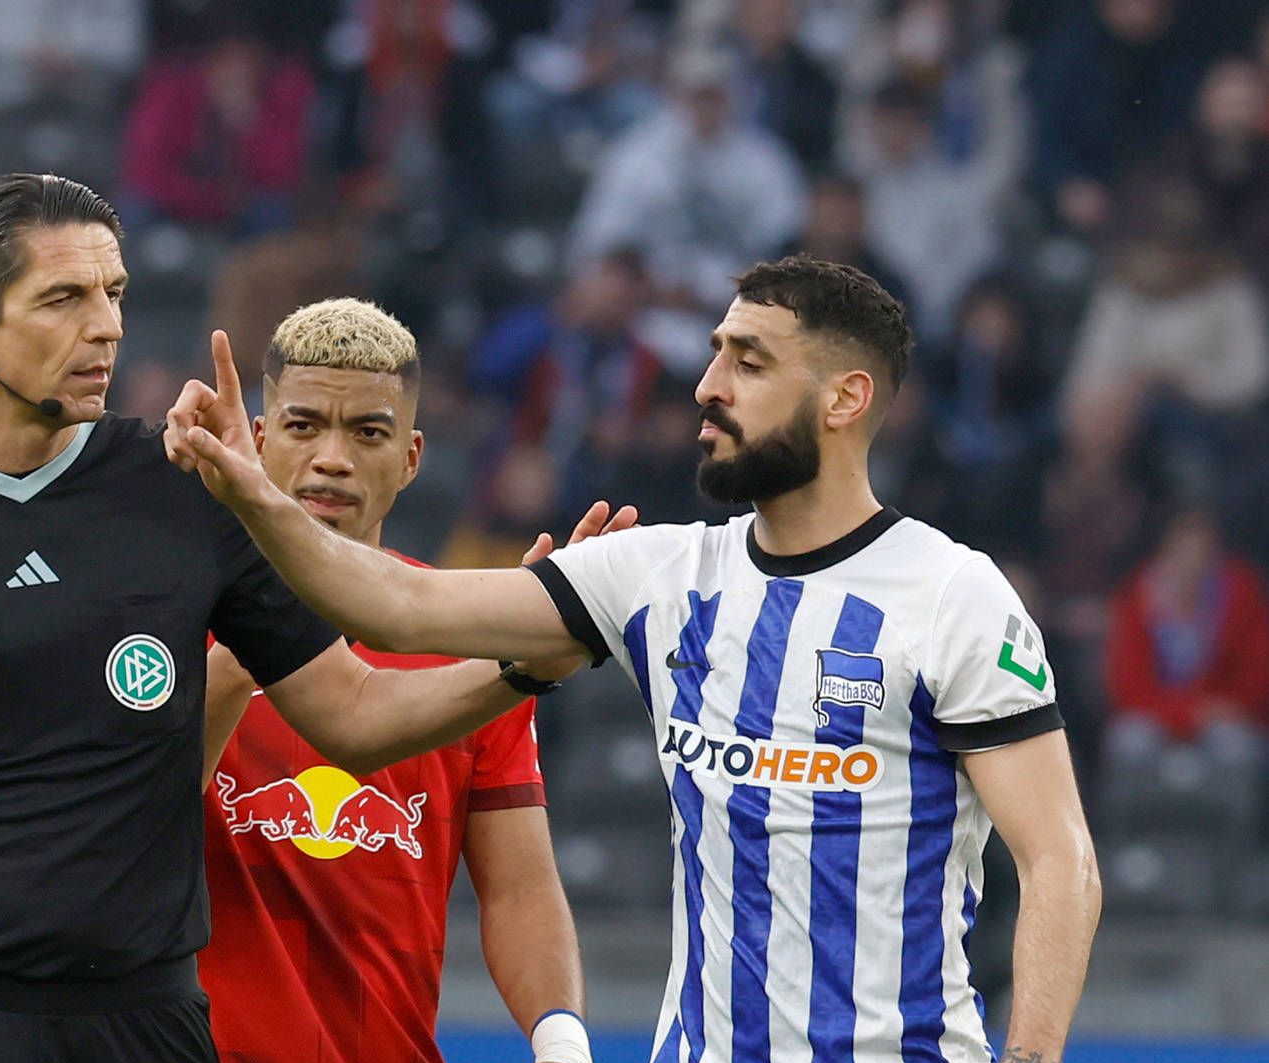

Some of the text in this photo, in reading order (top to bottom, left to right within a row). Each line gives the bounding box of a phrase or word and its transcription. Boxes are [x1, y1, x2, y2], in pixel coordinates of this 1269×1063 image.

[823, 678, 881, 703] Hertha BSC
[661, 725, 878, 785] AUTOHERO
